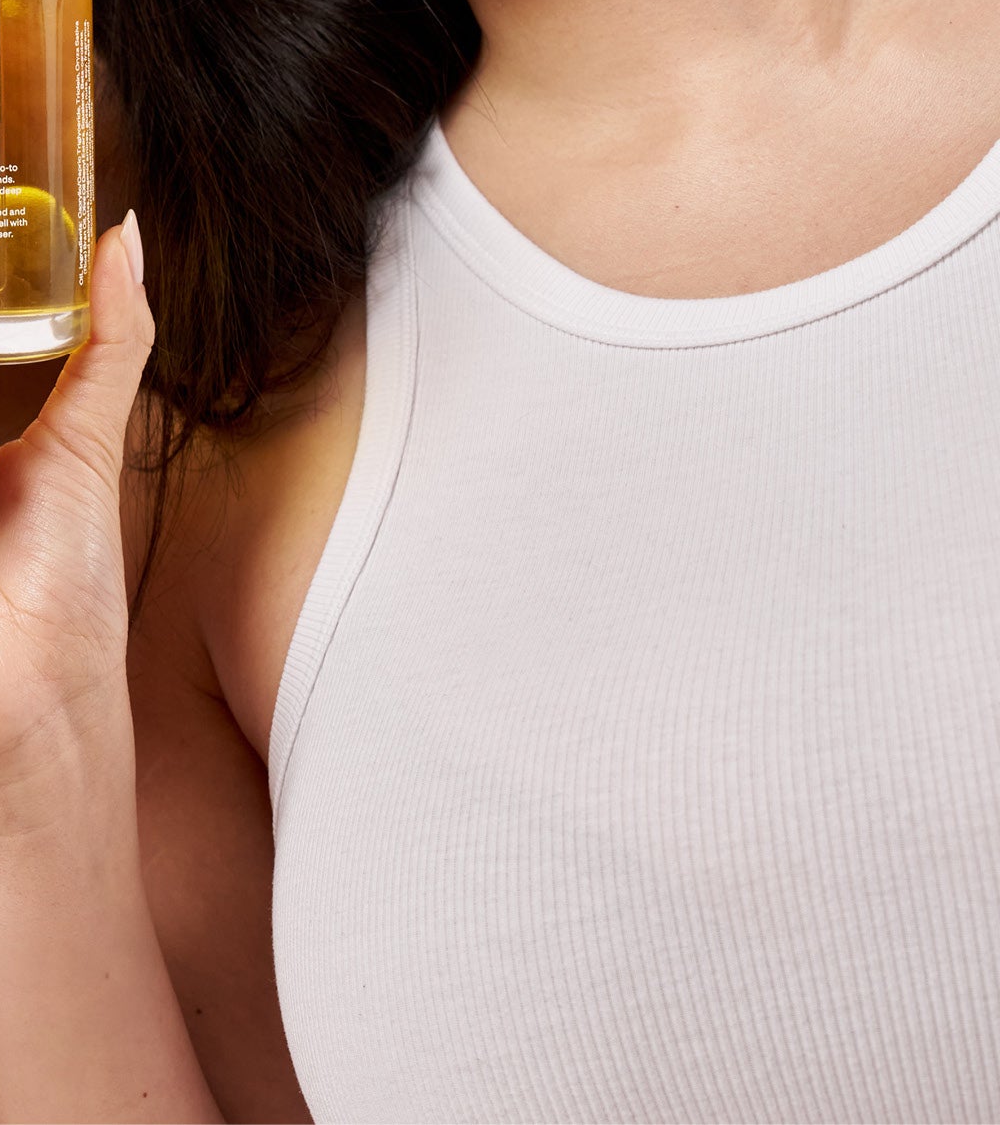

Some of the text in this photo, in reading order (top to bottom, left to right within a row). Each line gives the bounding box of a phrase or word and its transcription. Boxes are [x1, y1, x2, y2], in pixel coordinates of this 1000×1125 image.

[0, 186, 22, 196] deep
[9, 207, 26, 216] and
[10, 218, 28, 227] with
